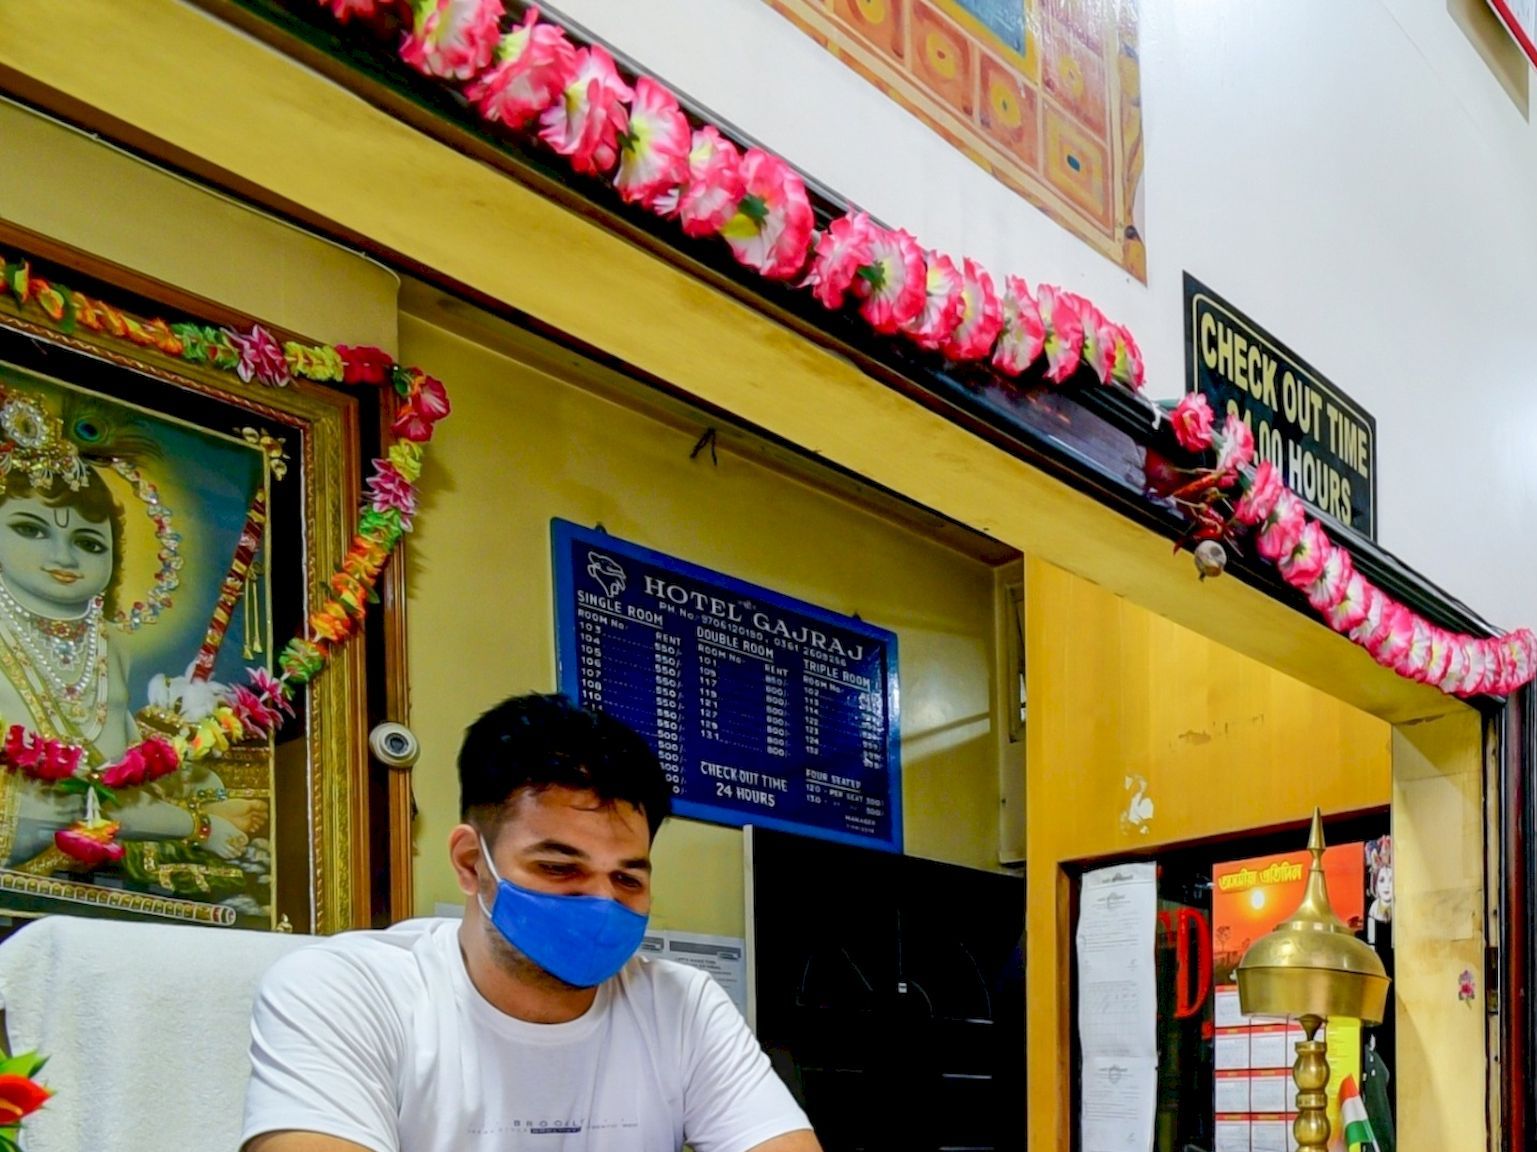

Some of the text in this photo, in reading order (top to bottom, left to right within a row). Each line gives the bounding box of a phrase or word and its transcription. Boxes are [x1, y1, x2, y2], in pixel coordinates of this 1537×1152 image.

[1201, 311, 1368, 479] CHECK OUT TIME
[1289, 439, 1352, 525] HOURS
[577, 590, 663, 626] SINGLE ROOM
[577, 608, 608, 625] ROOM
[644, 575, 864, 660] HOTEL GAJRAJ
[579, 621, 601, 634] 103
[580, 633, 600, 645] 104
[655, 631, 681, 647] RENT
[696, 626, 774, 659] DOUBLE ROOM
[581, 645, 602, 657] 105
[697, 643, 726, 659] ROOM
[699, 655, 717, 667] 101
[581, 668, 601, 679] 107
[765, 663, 789, 677] RENT
[803, 659, 870, 688] TRIPLE ROOM
[802, 675, 827, 690] ROOM
[582, 690, 602, 701] 110
[700, 698, 718, 709] 121
[700, 708, 718, 719] 127
[805, 768, 828, 781] FOUR
[761, 774, 788, 792] TIME
[716, 782, 775, 808] 24 HOURS
